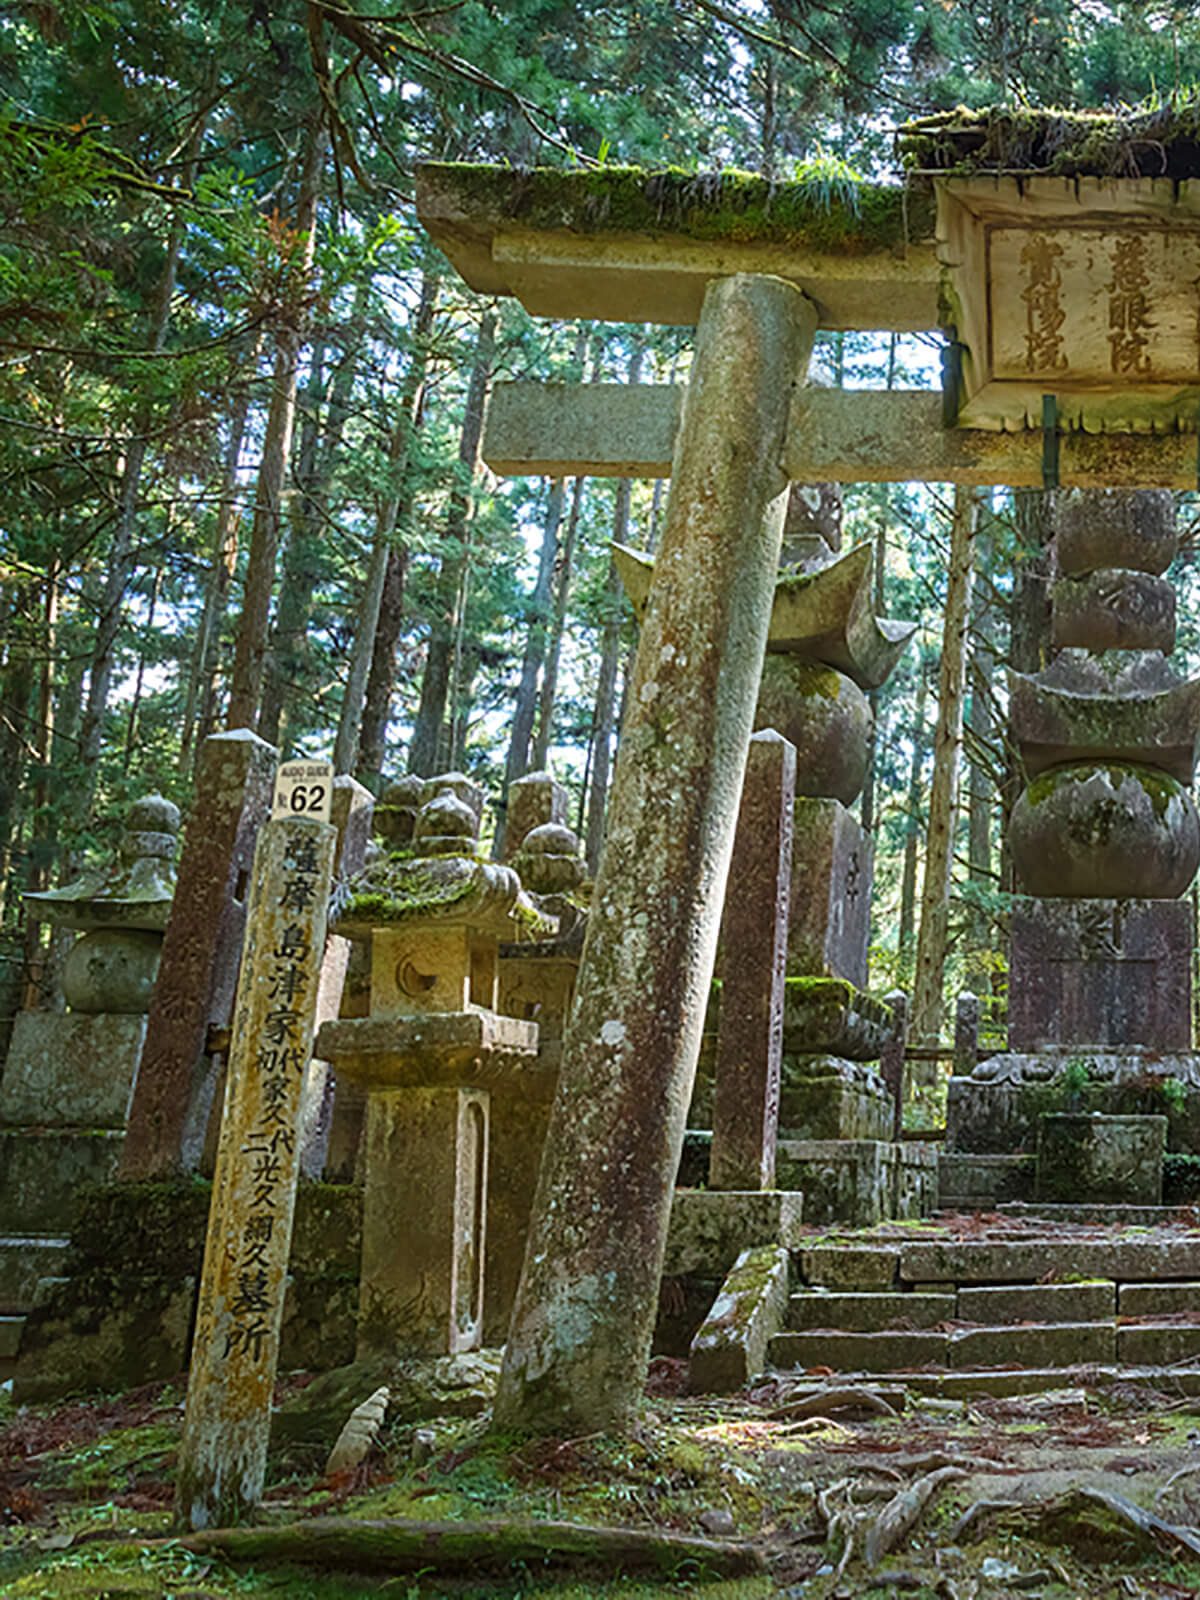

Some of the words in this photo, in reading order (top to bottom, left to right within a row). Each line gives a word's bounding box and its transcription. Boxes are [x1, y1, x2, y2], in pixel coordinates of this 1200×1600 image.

[1104, 235, 1156, 373] 慈眼院
[291, 785, 325, 812] 62
